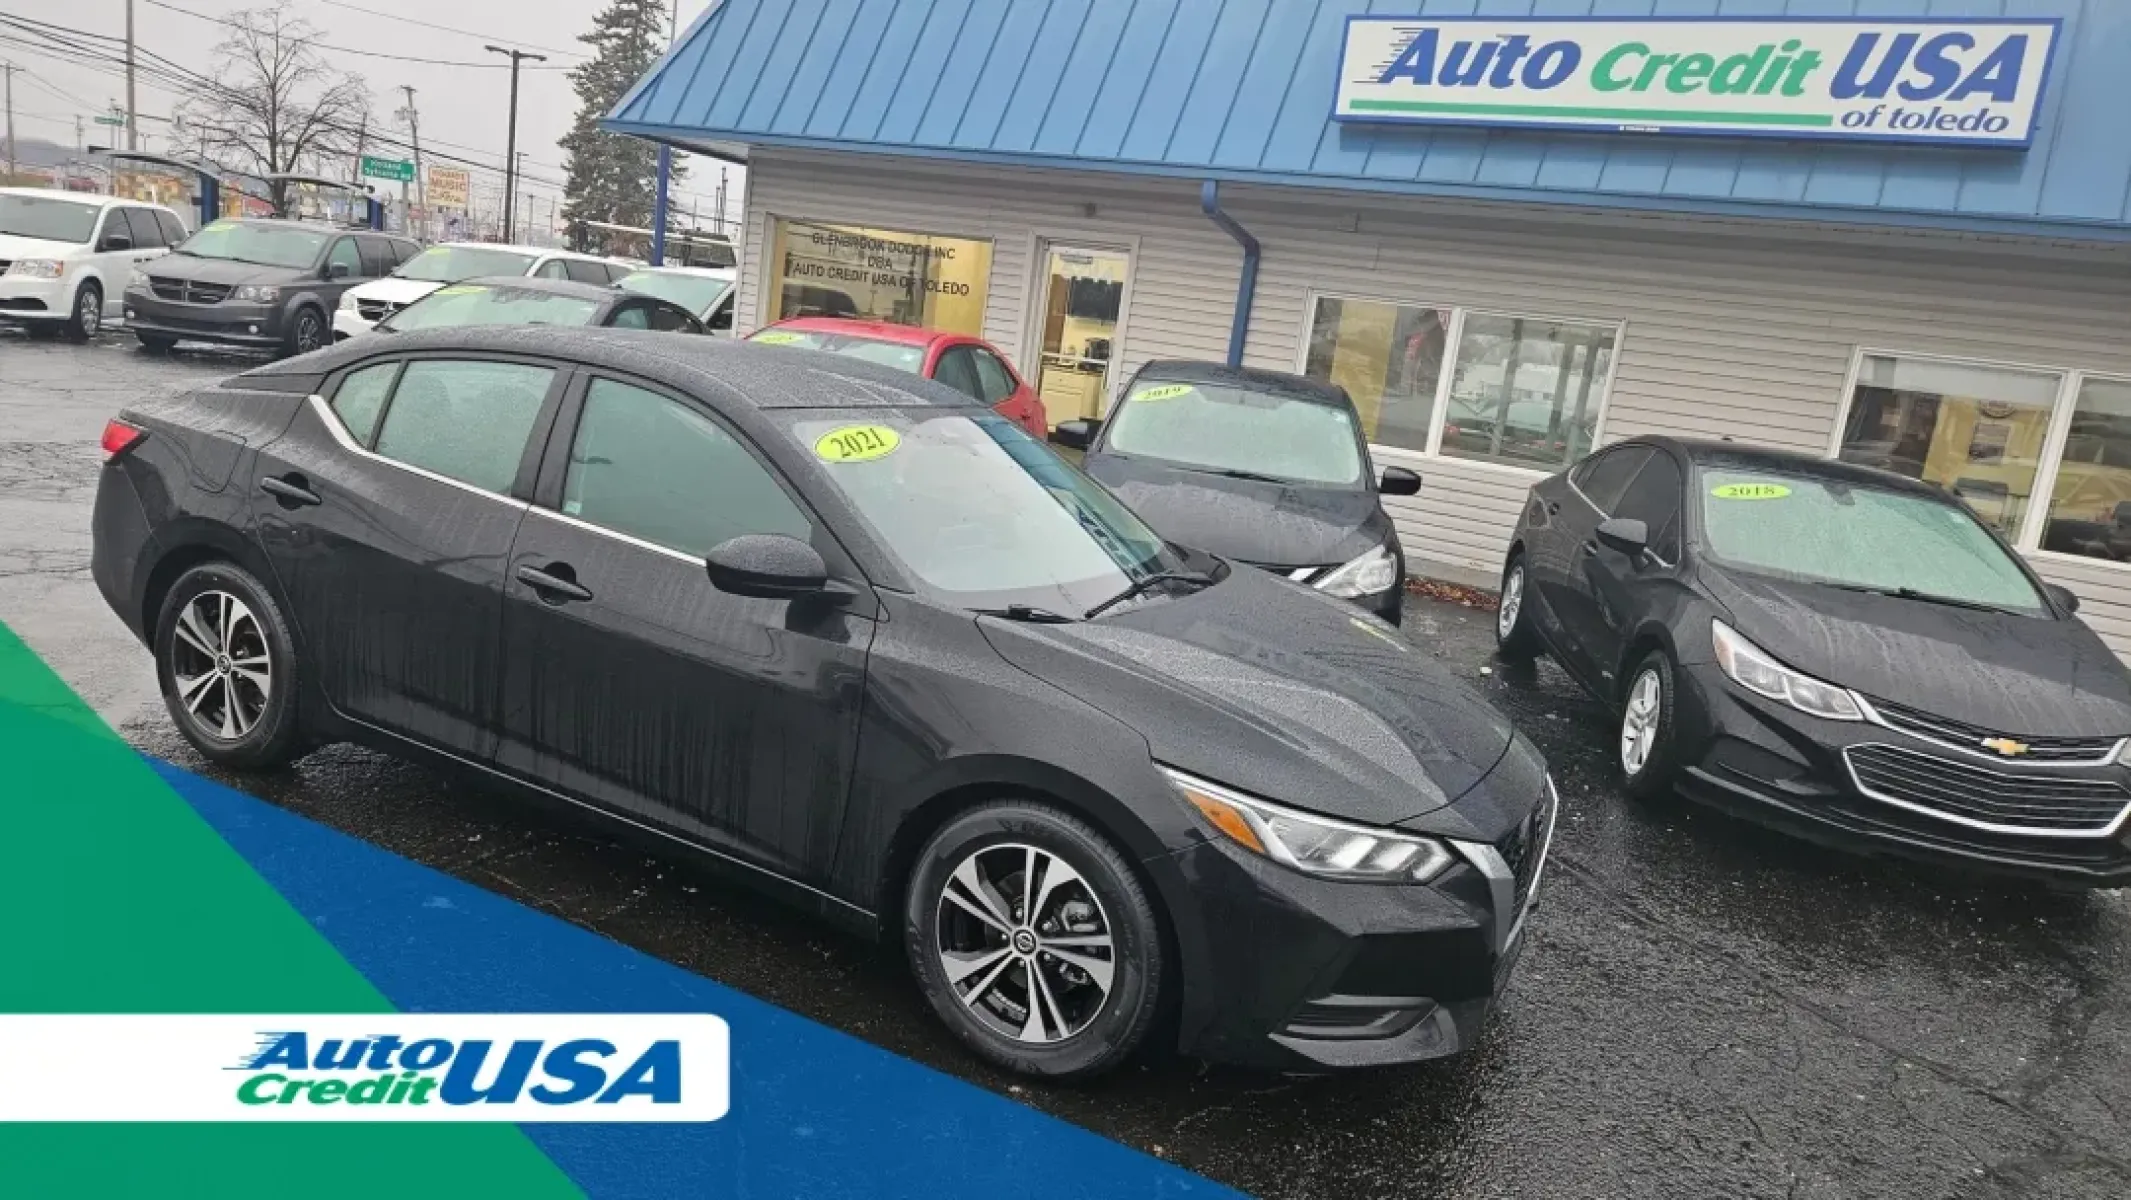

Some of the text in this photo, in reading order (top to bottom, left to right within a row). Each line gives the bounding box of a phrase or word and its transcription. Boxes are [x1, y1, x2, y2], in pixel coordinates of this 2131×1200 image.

[1376, 27, 2029, 103] Auto Credit USA
[1840, 104, 2010, 133] of toledo
[811, 232, 886, 251] GLENBROOK
[934, 246, 956, 260] INC
[793, 262, 825, 277] AUTO
[827, 265, 870, 284] CREDIT
[872, 273, 897, 288] USA
[867, 256, 893, 270] DBA
[830, 427, 886, 459] 2021
[1727, 484, 1775, 497] 2018
